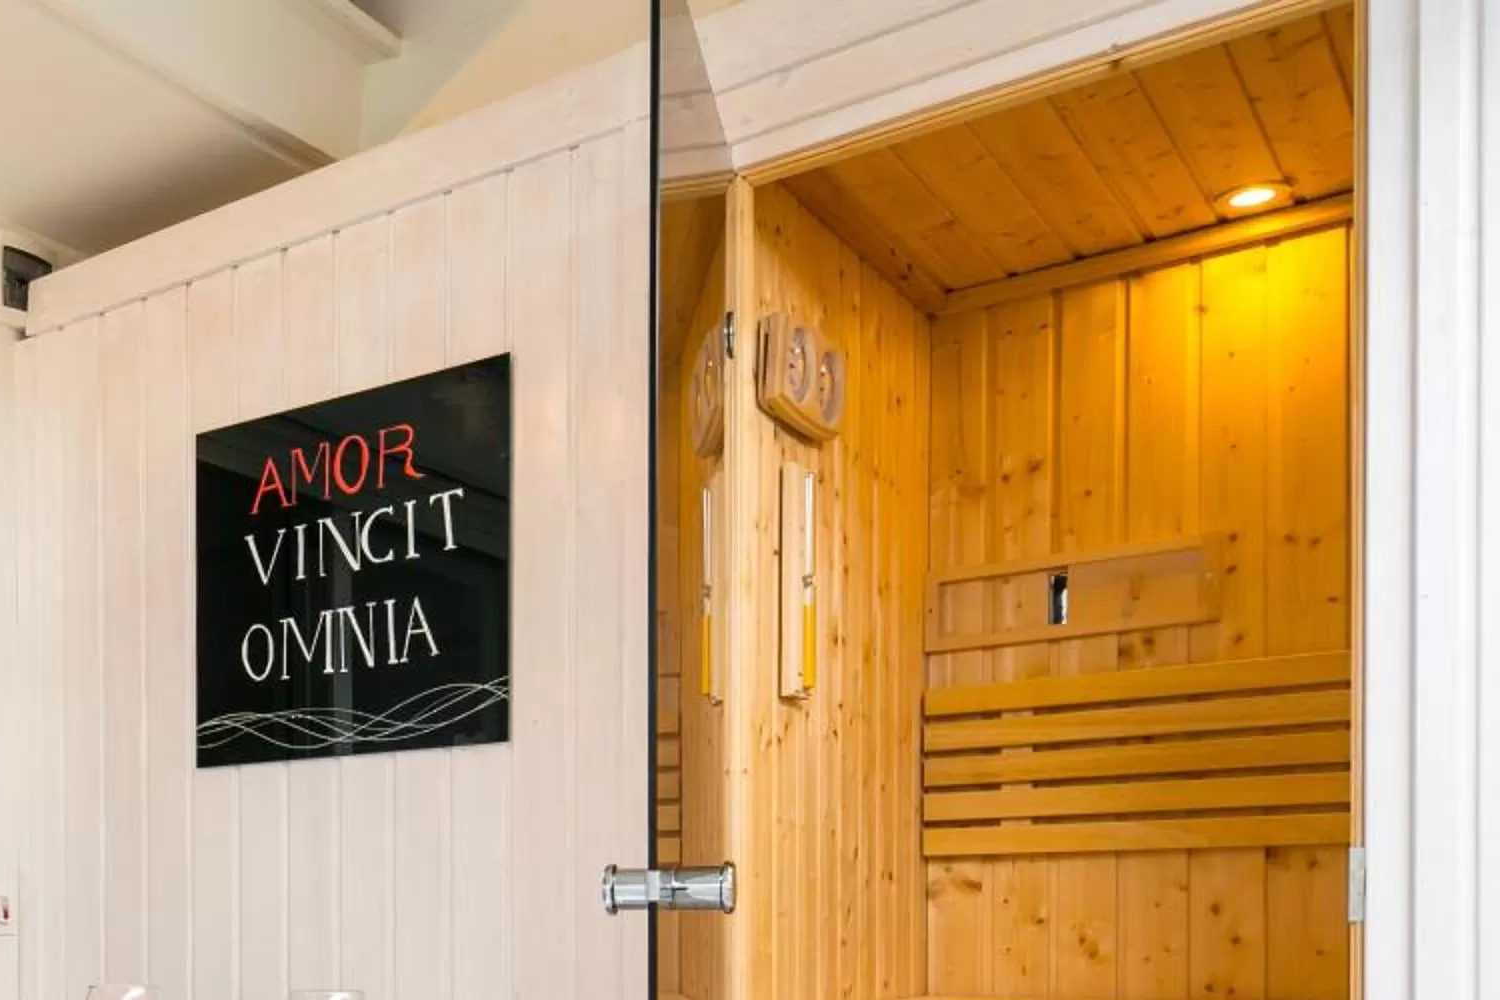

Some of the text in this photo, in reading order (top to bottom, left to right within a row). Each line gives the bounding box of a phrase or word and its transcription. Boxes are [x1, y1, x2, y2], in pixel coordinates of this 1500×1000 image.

[250, 423, 426, 514] AMOR
[244, 488, 464, 586] VINCIT
[241, 596, 440, 681] OMNIA
